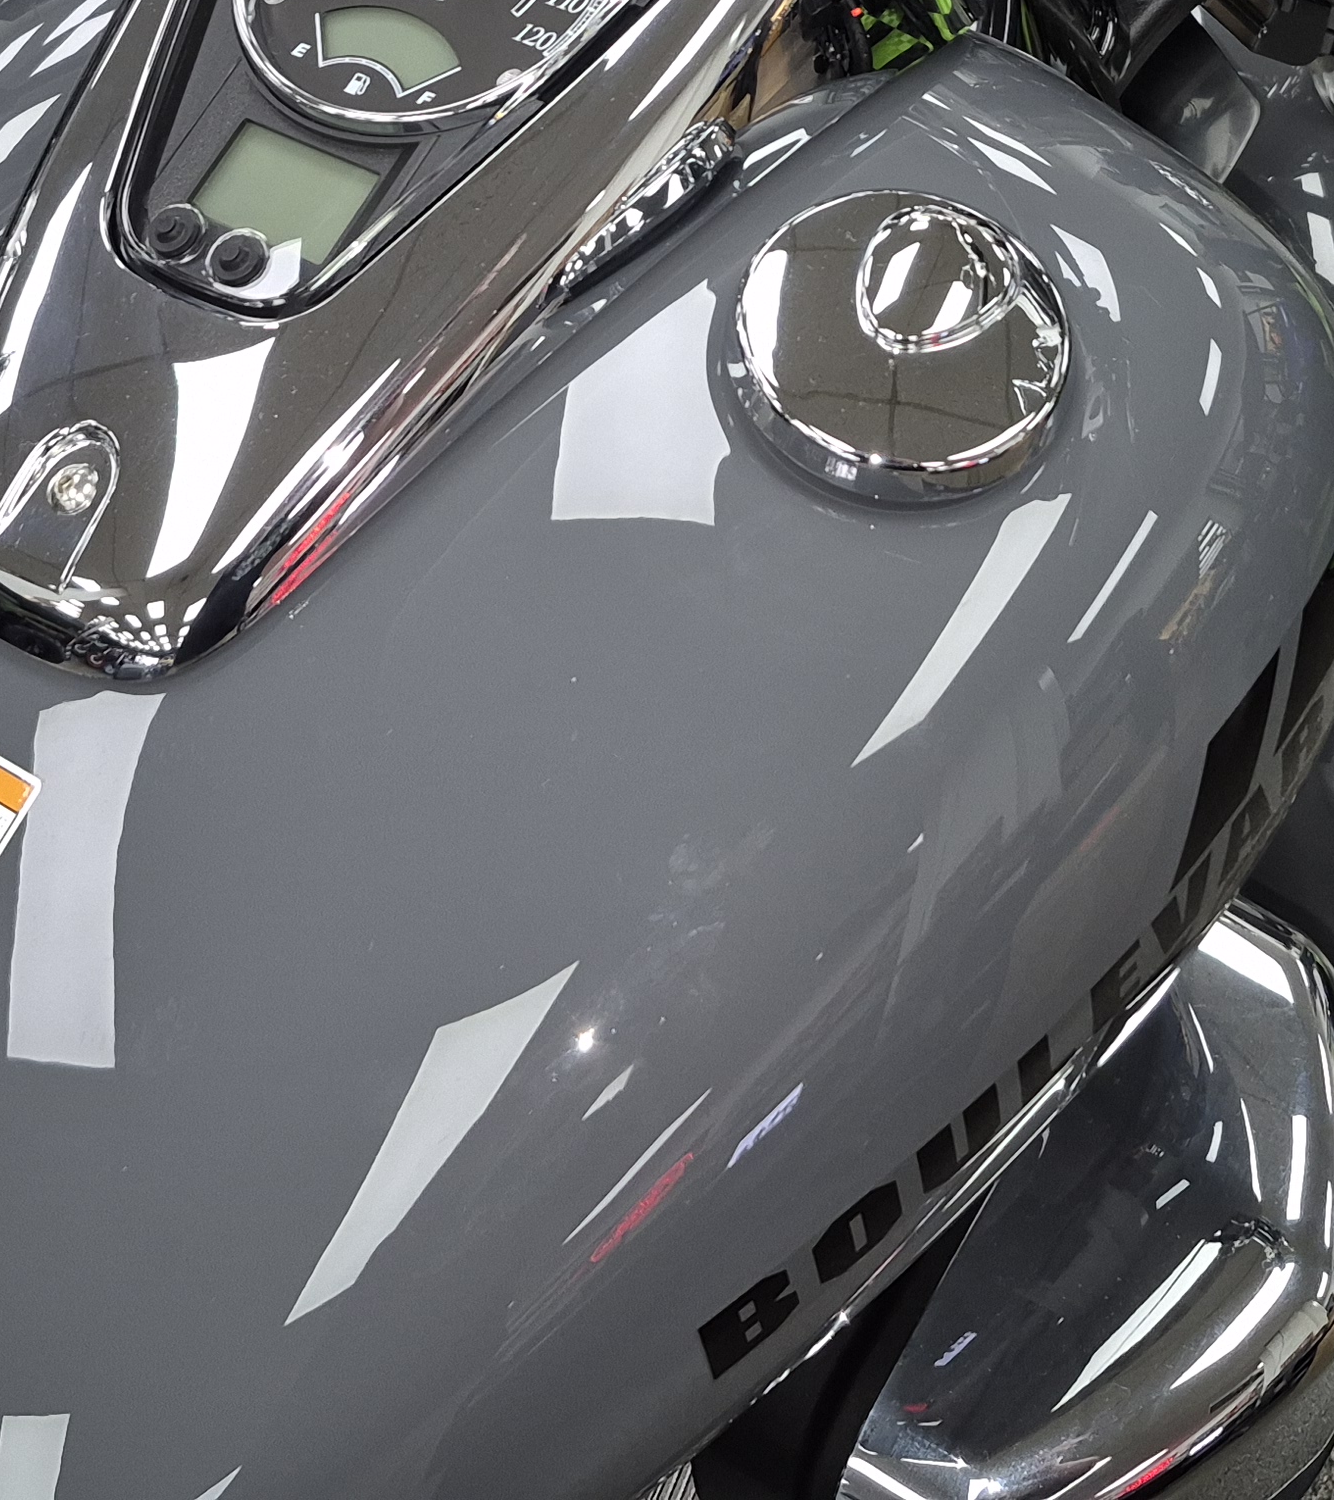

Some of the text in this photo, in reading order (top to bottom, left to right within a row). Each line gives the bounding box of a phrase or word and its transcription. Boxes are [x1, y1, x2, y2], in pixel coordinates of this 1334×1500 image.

[512, 22, 559, 51] 120
[290, 41, 311, 59] E
[415, 90, 438, 106] F
